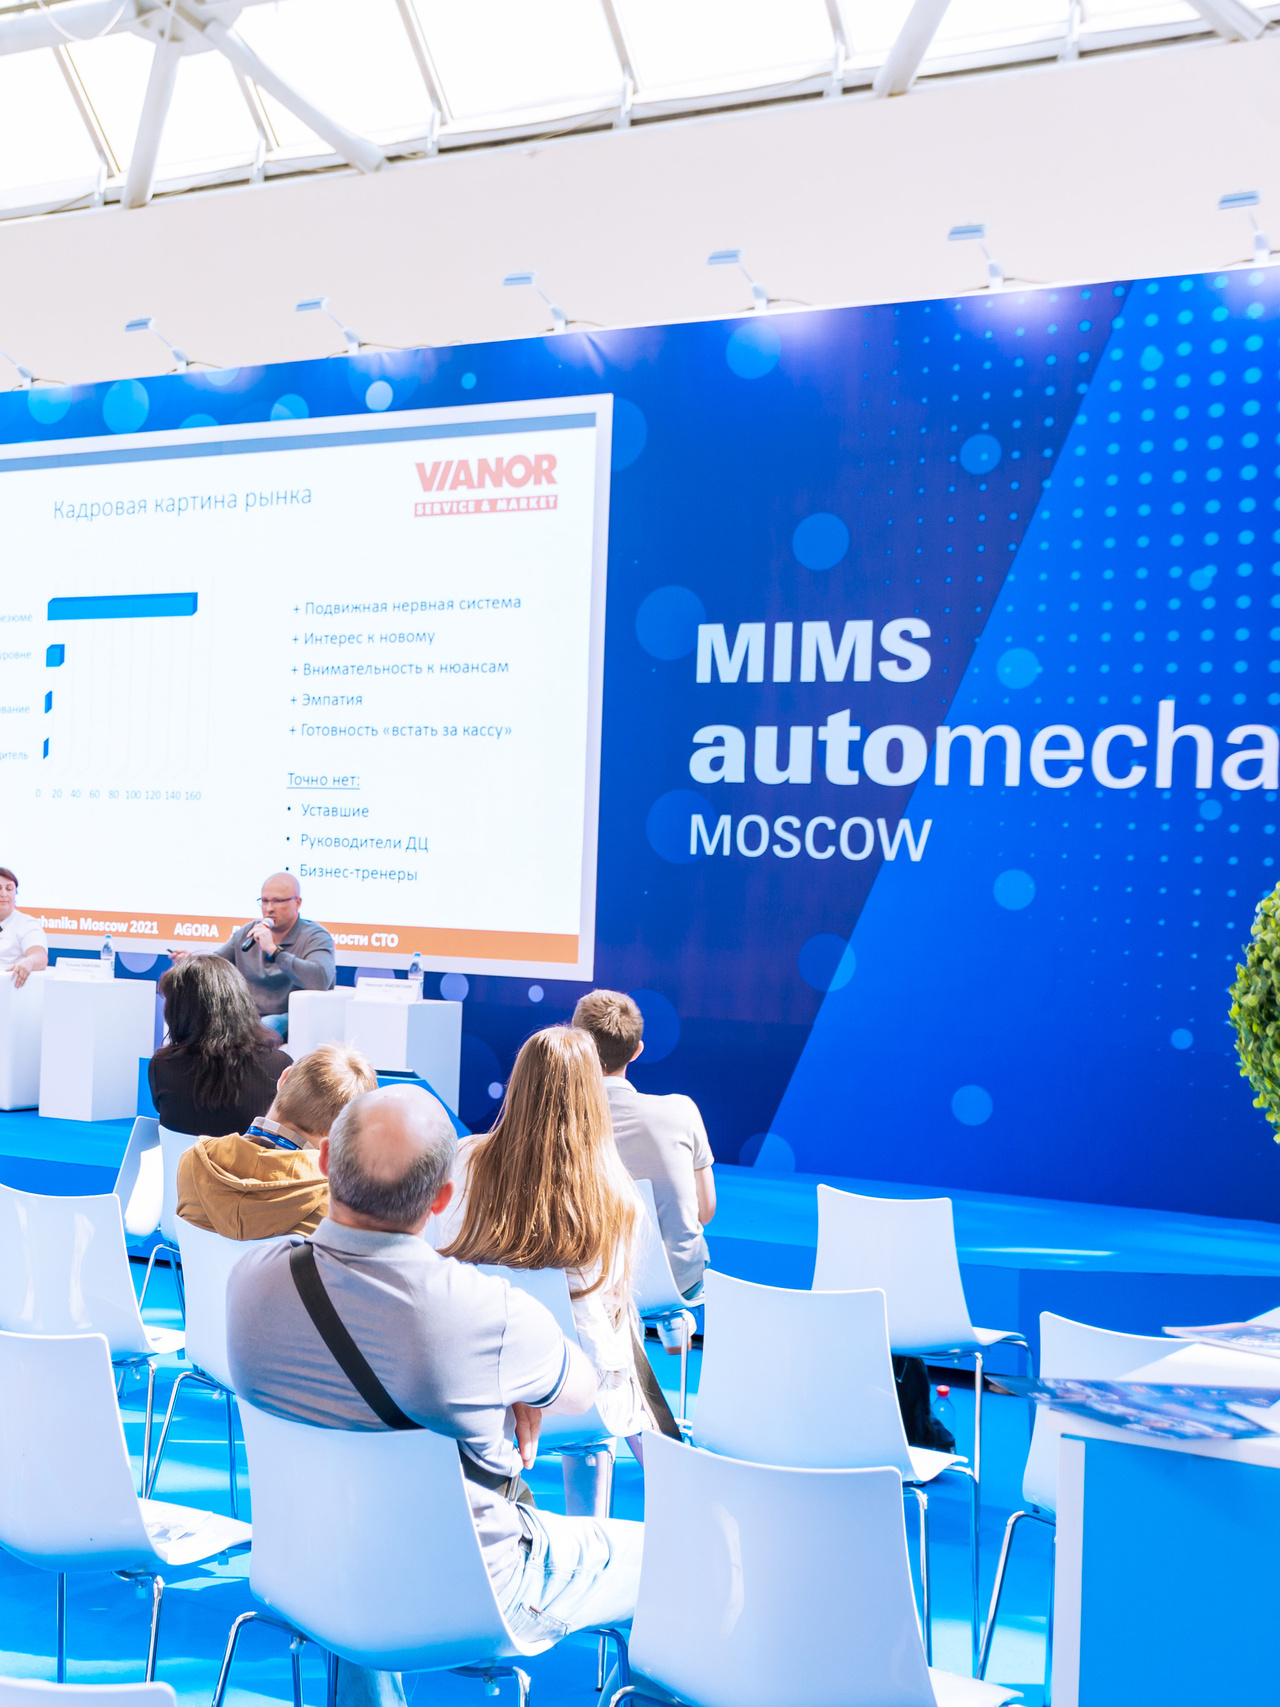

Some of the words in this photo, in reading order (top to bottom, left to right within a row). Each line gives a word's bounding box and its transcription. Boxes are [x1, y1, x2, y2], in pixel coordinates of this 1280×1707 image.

[415, 454, 558, 492] VIANOR
[54, 500, 147, 522] Кадровая
[154, 493, 237, 516] картина
[245, 488, 312, 512] рынка
[416, 501, 476, 516] SERVICE
[481, 500, 490, 512] &
[496, 496, 556, 511] MARKET
[305, 601, 387, 617] Подвижная
[392, 599, 454, 615] нервная
[459, 597, 521, 611] система
[304, 632, 363, 647] Интерес
[368, 633, 375, 644] к
[380, 632, 435, 645] новому
[695, 617, 932, 683] MIMS
[303, 663, 422, 676] Внимательность
[427, 663, 435, 673] к
[440, 662, 509, 674] нюансам
[302, 694, 363, 706] Эмпатия
[301, 724, 378, 736] Готовность
[383, 725, 438, 737] «встать
[442, 726, 457, 736] за
[463, 726, 512, 740] кассу»
[287, 773, 328, 786] Точно
[333, 776, 360, 787] нет:
[126, 790, 142, 800] 100
[145, 790, 161, 800] 120
[165, 791, 181, 800] 140
[185, 791, 201, 801] 160
[301, 803, 369, 817] Уставшие
[301, 834, 402, 850] Руководители
[405, 837, 429, 853] ДЦ
[689, 814, 933, 862] MOSCOW
[300, 864, 418, 883] Бизнес-тренеры
[80, 917, 128, 933] Moscow
[129, 920, 159, 935] 2021
[173, 922, 219, 938] AGORA
[371, 933, 399, 948] СТО
